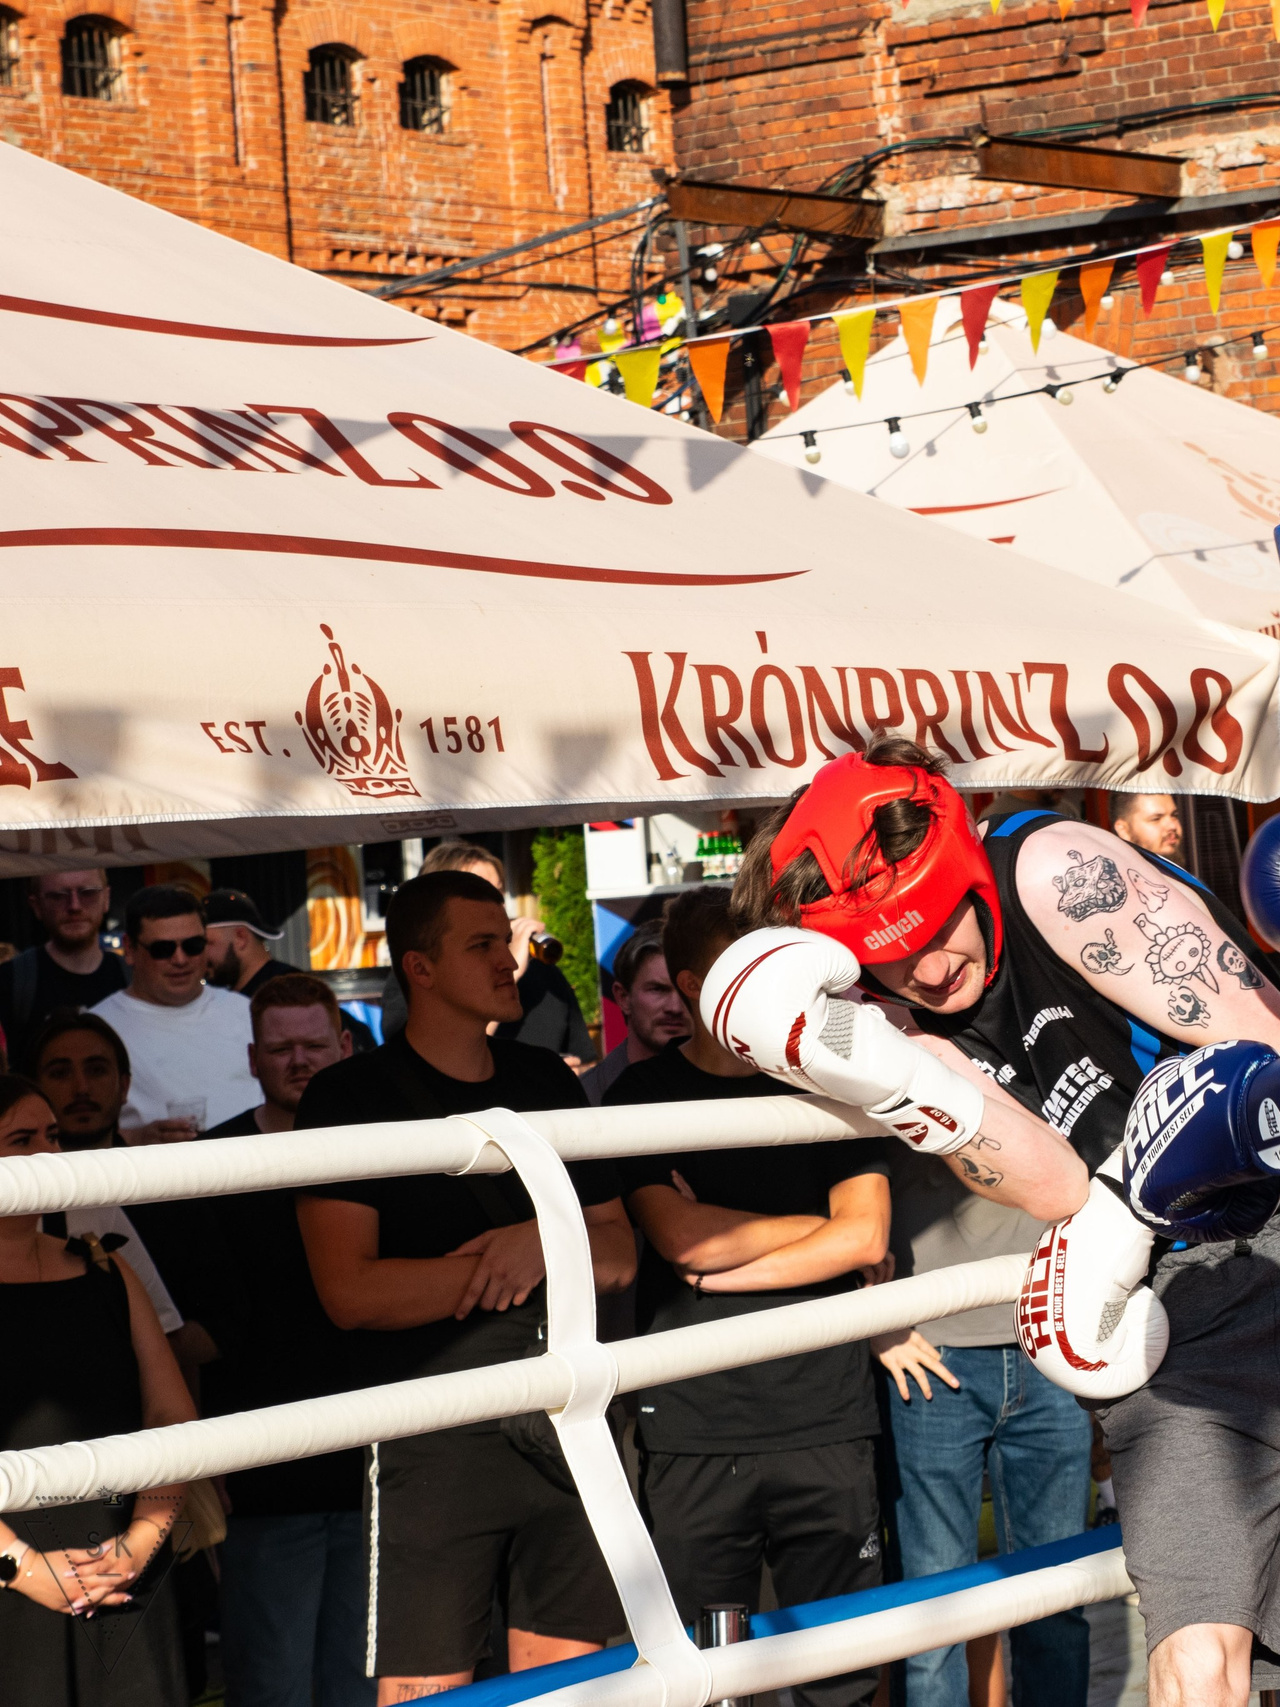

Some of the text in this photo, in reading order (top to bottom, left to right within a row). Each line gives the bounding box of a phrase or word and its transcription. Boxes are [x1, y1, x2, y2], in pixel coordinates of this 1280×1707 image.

[200, 716, 506, 758] EST. 1581
[863, 909, 925, 951] clinch
[1124, 1067, 1215, 1171] HILL
[1146, 1139, 1164, 1164] YOUR
[1162, 1121, 1180, 1143] BEST
[1179, 1102, 1197, 1124] SELF
[1030, 1225, 1058, 1351] HILL
[1053, 1248, 1067, 1333] BE YOUR BEST SELF
